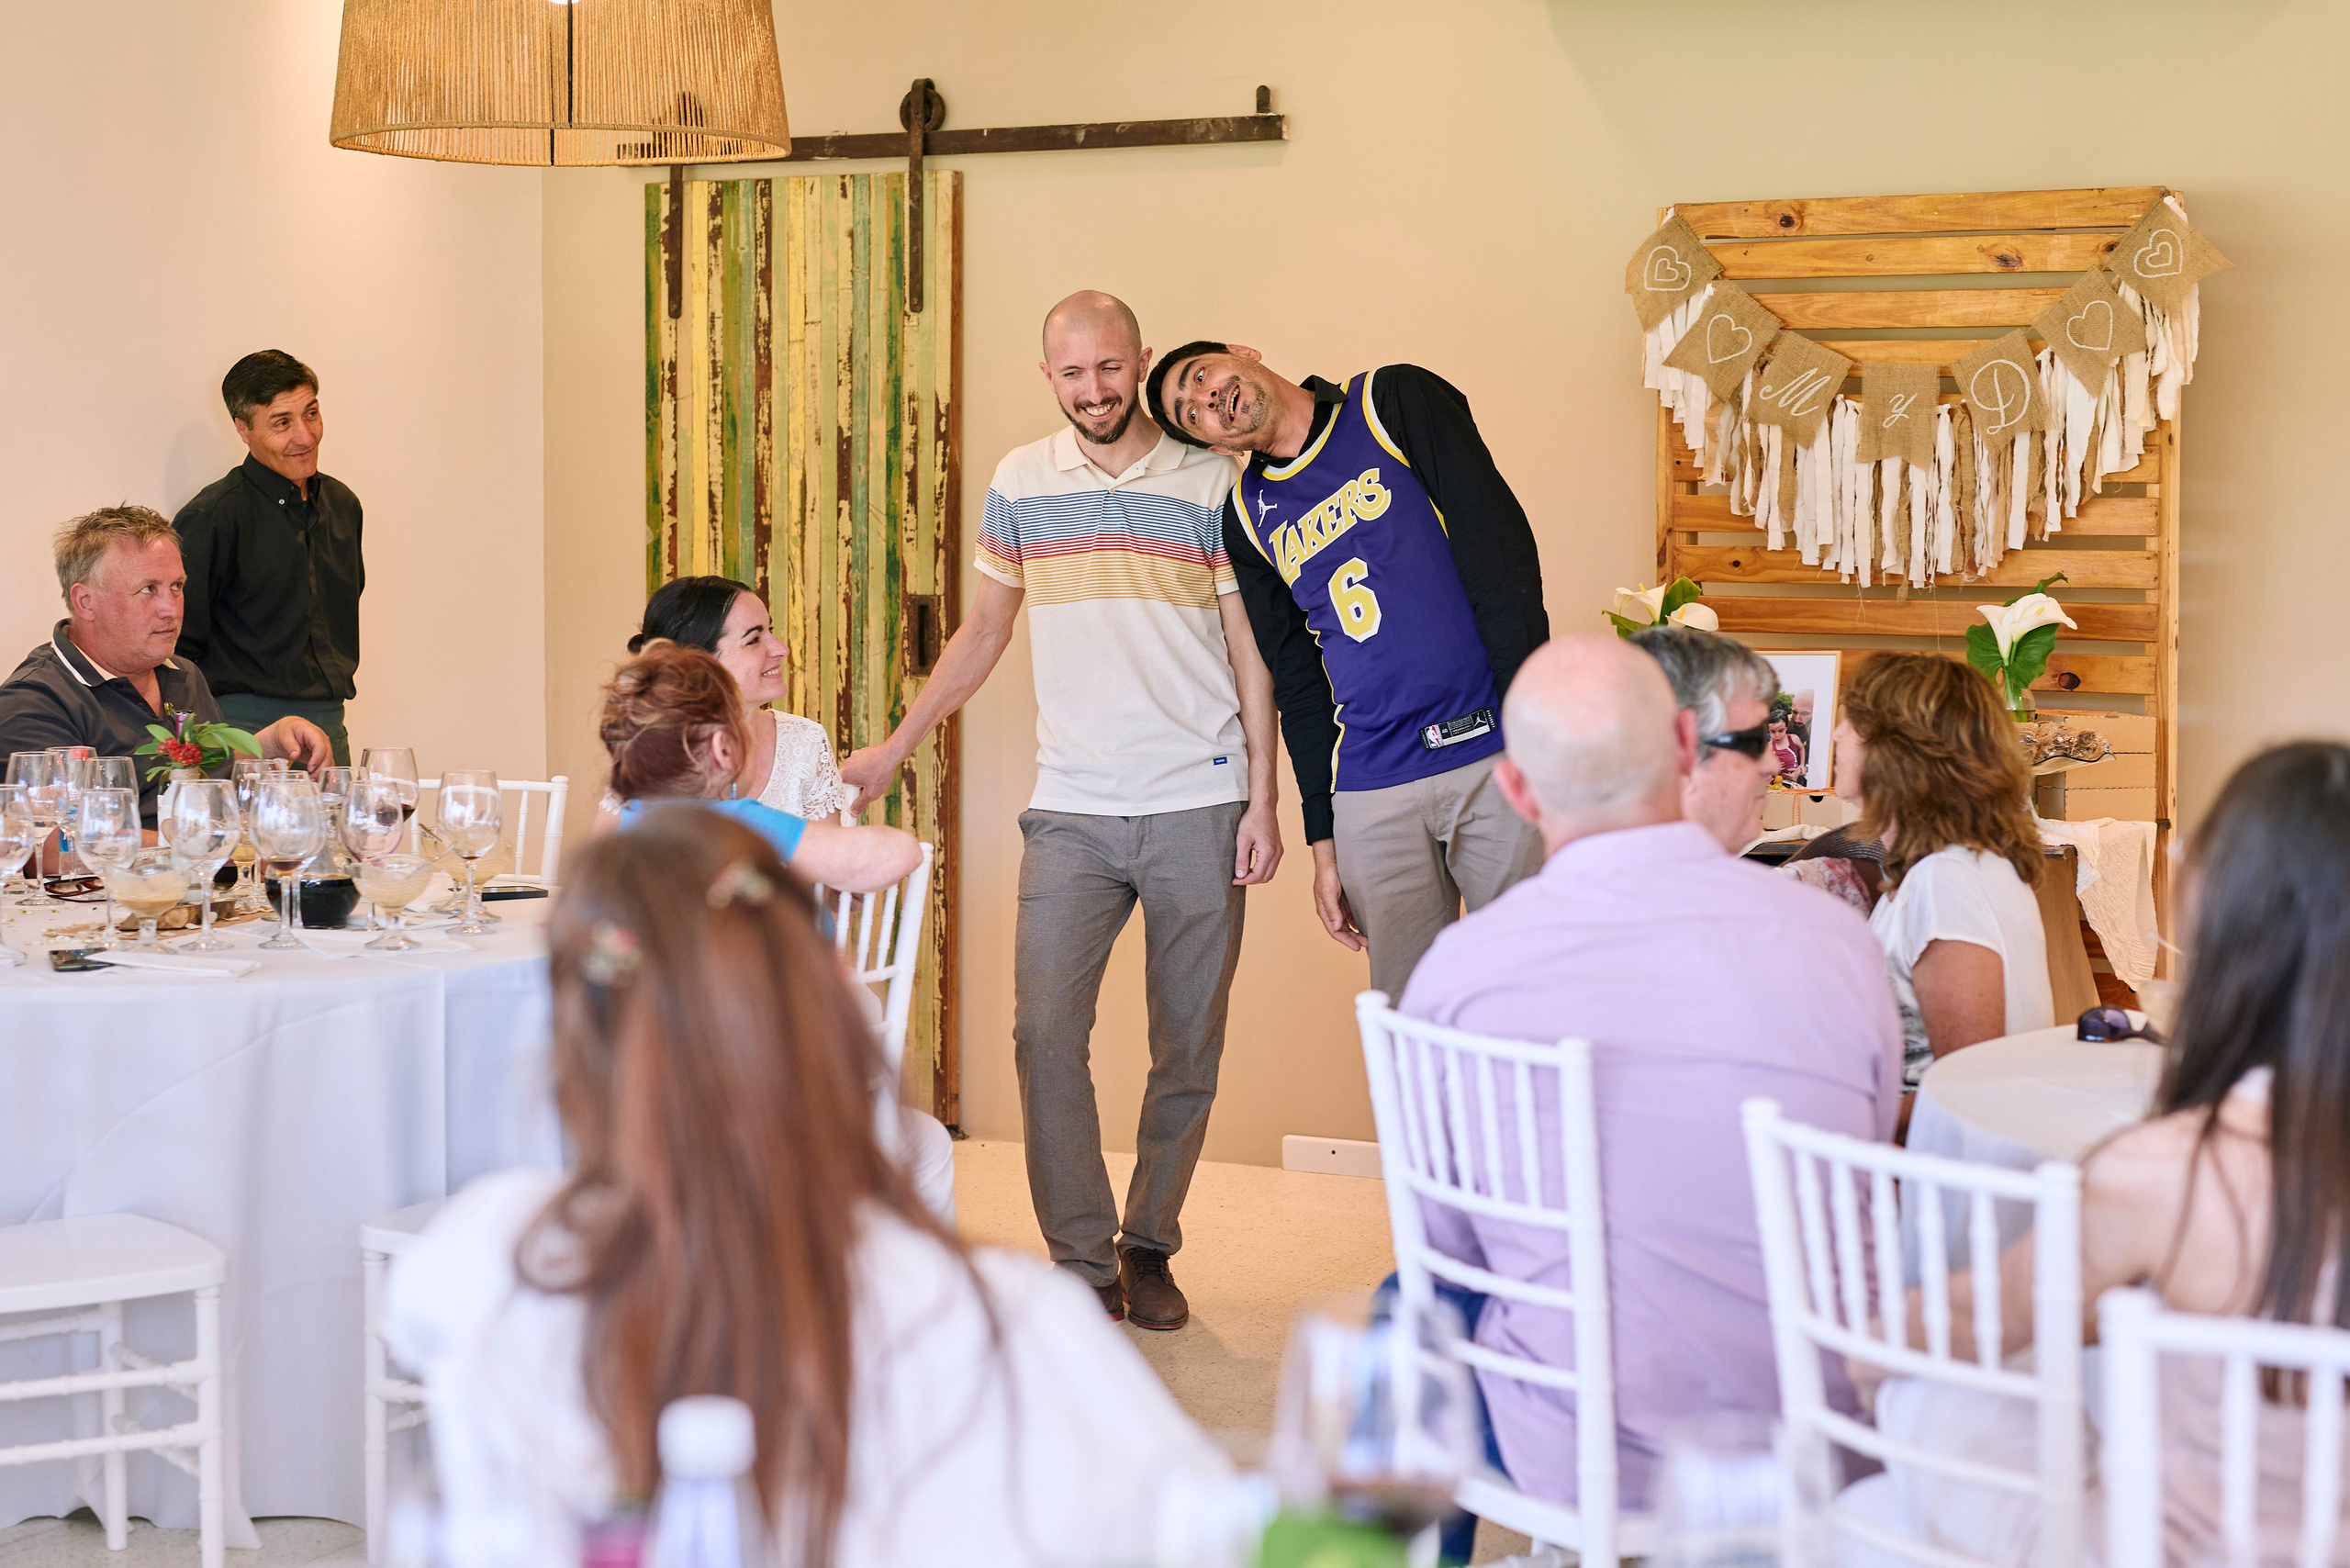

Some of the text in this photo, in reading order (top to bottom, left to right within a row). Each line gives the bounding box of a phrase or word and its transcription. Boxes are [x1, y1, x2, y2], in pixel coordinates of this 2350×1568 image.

[1759, 358, 2031, 435] M y D
[1268, 466, 1393, 588] LAKERS
[1327, 556, 1382, 643] 6
